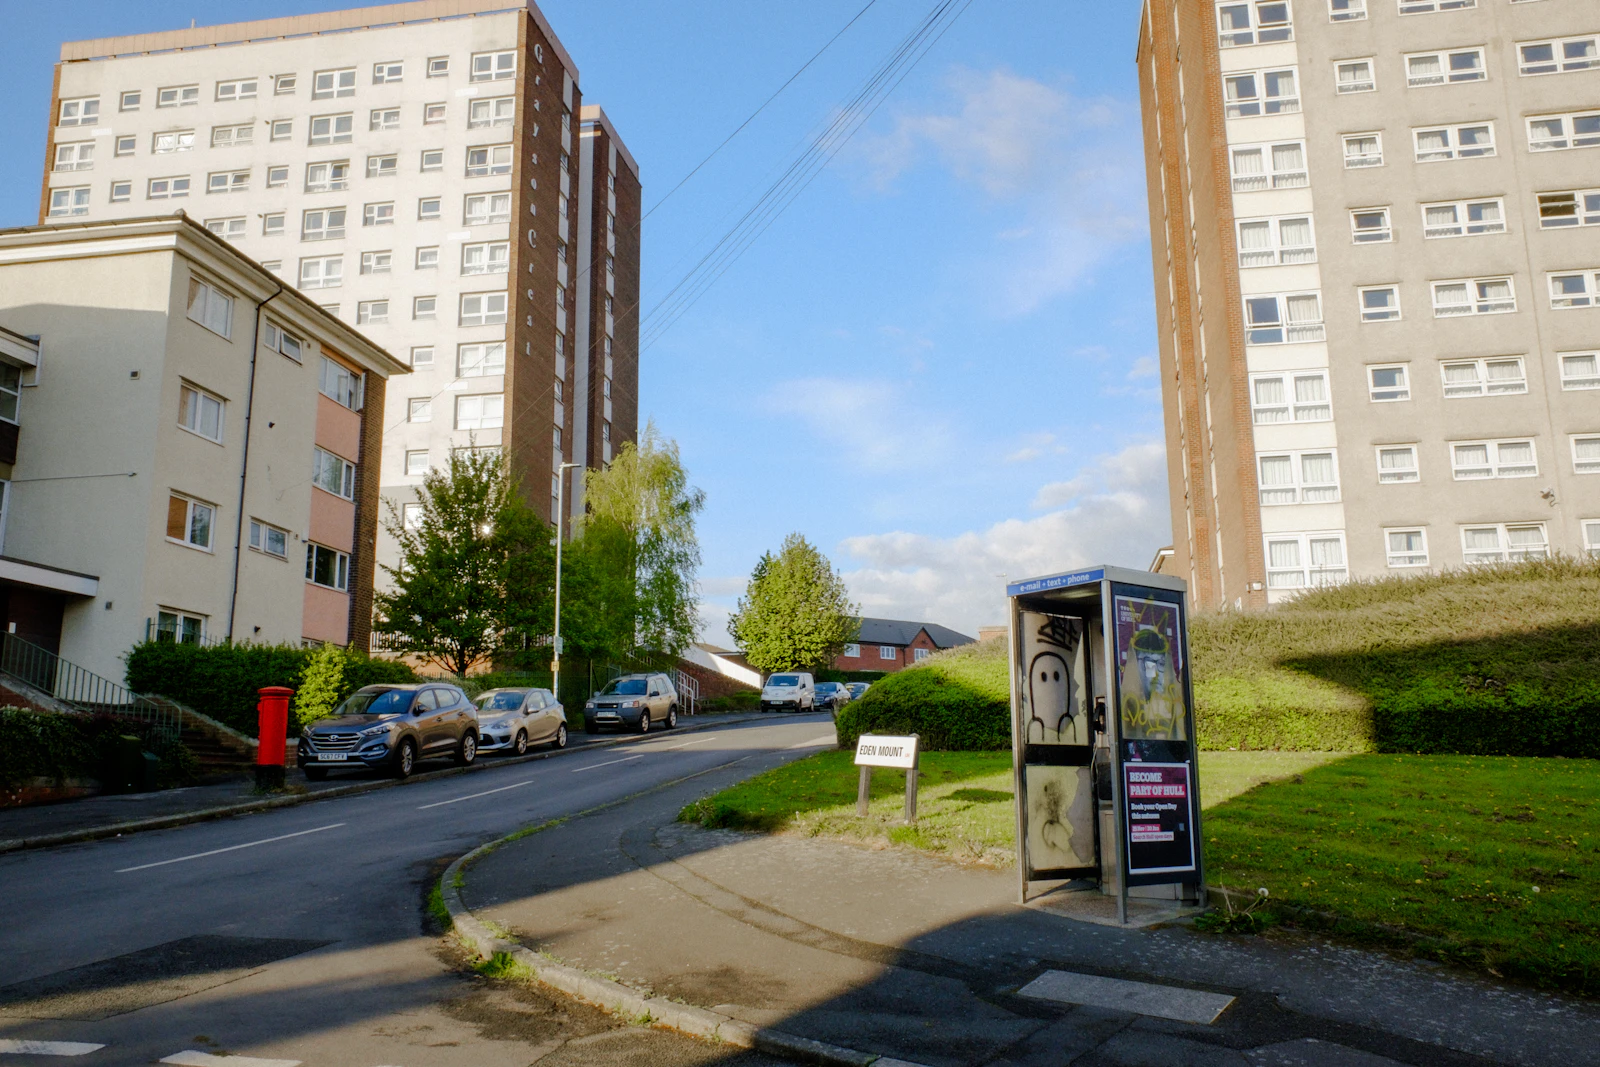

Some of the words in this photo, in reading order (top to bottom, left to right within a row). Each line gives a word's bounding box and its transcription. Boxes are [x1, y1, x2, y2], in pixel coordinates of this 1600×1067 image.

[530, 43, 542, 217] Grayson
[526, 229, 537, 356] Crest
[1020, 581, 1040, 592] e-mail
[1047, 578, 1061, 586] text
[1068, 574, 1090, 584] phone
[860, 745, 877, 756] EDEN
[878, 746, 904, 757] MOUNT
[1130, 772, 1162, 782] BECOME
[1130, 786, 1152, 796] PART
[1152, 786, 1164, 796] OF
[1164, 786, 1184, 796] HULL
